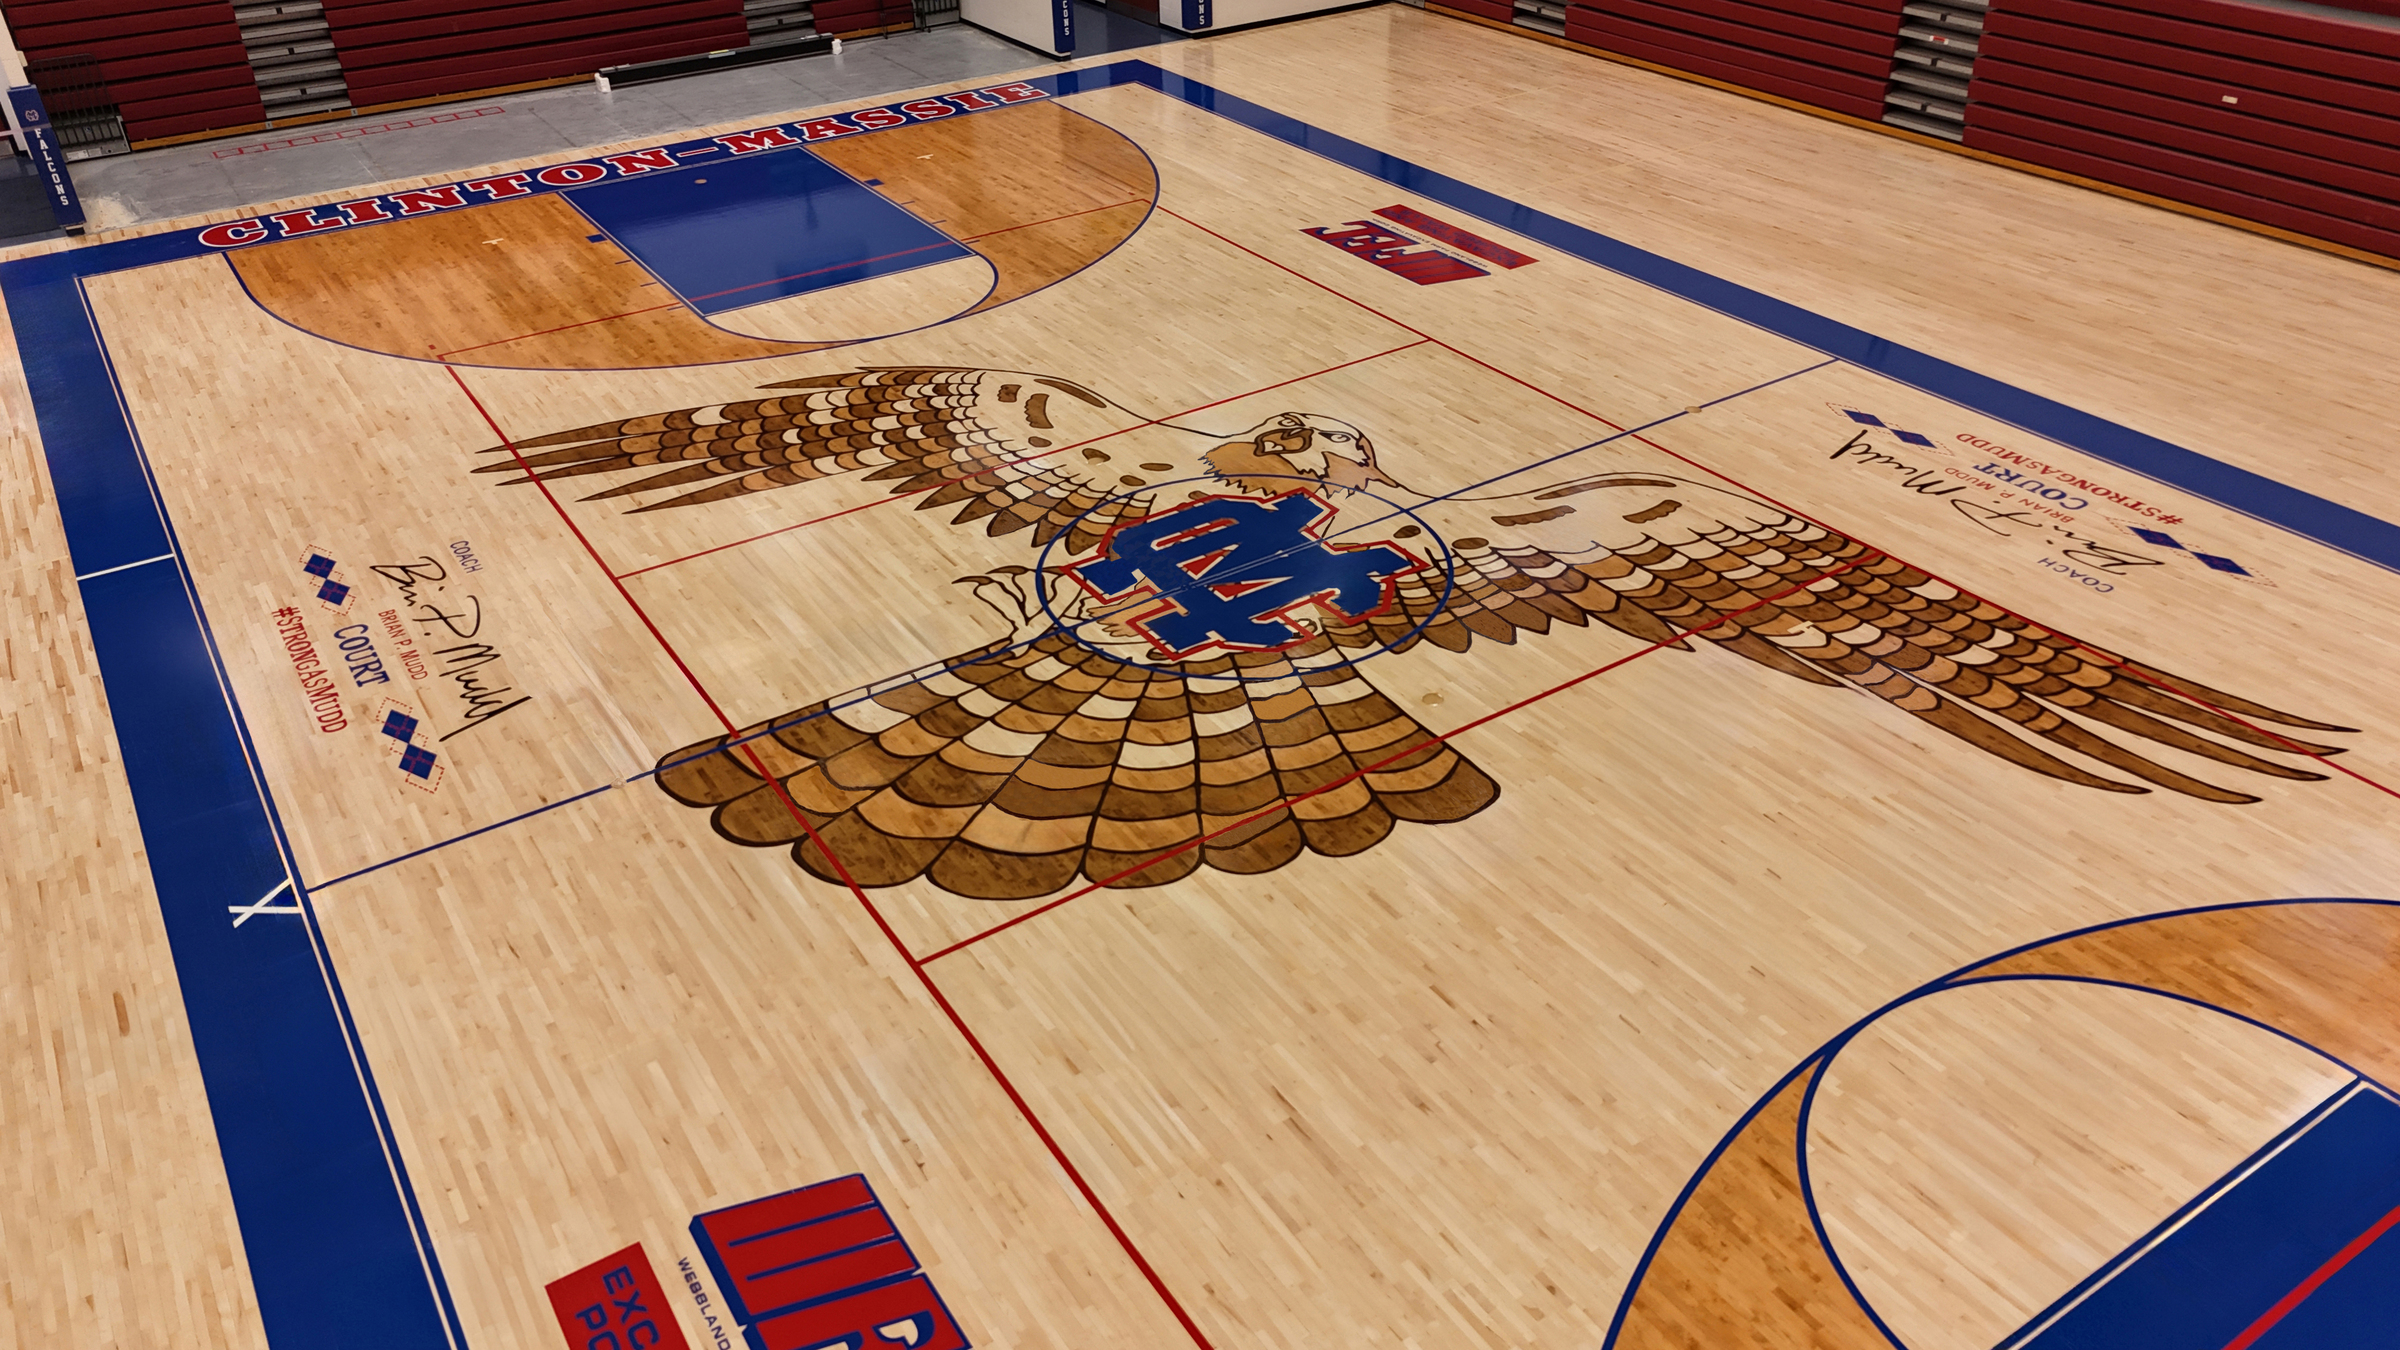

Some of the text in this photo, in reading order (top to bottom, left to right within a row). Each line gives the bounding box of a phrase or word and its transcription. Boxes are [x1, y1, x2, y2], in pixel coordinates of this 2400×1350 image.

[34, 128, 69, 206] FALCONS
[198, 82, 1051, 248] CLINTON-MASSIE
[1944, 466, 1996, 491] MUDD
[1972, 461, 2089, 511] COURT
[2019, 498, 2075, 524] BRIAN
[450, 540, 483, 574] COACH
[2037, 557, 2115, 594] COACH
[333, 623, 391, 688] COURT
[378, 609, 403, 641] BRIAN
[400, 649, 428, 681] MUDD
[678, 1257, 732, 1350] WEBBLAND
